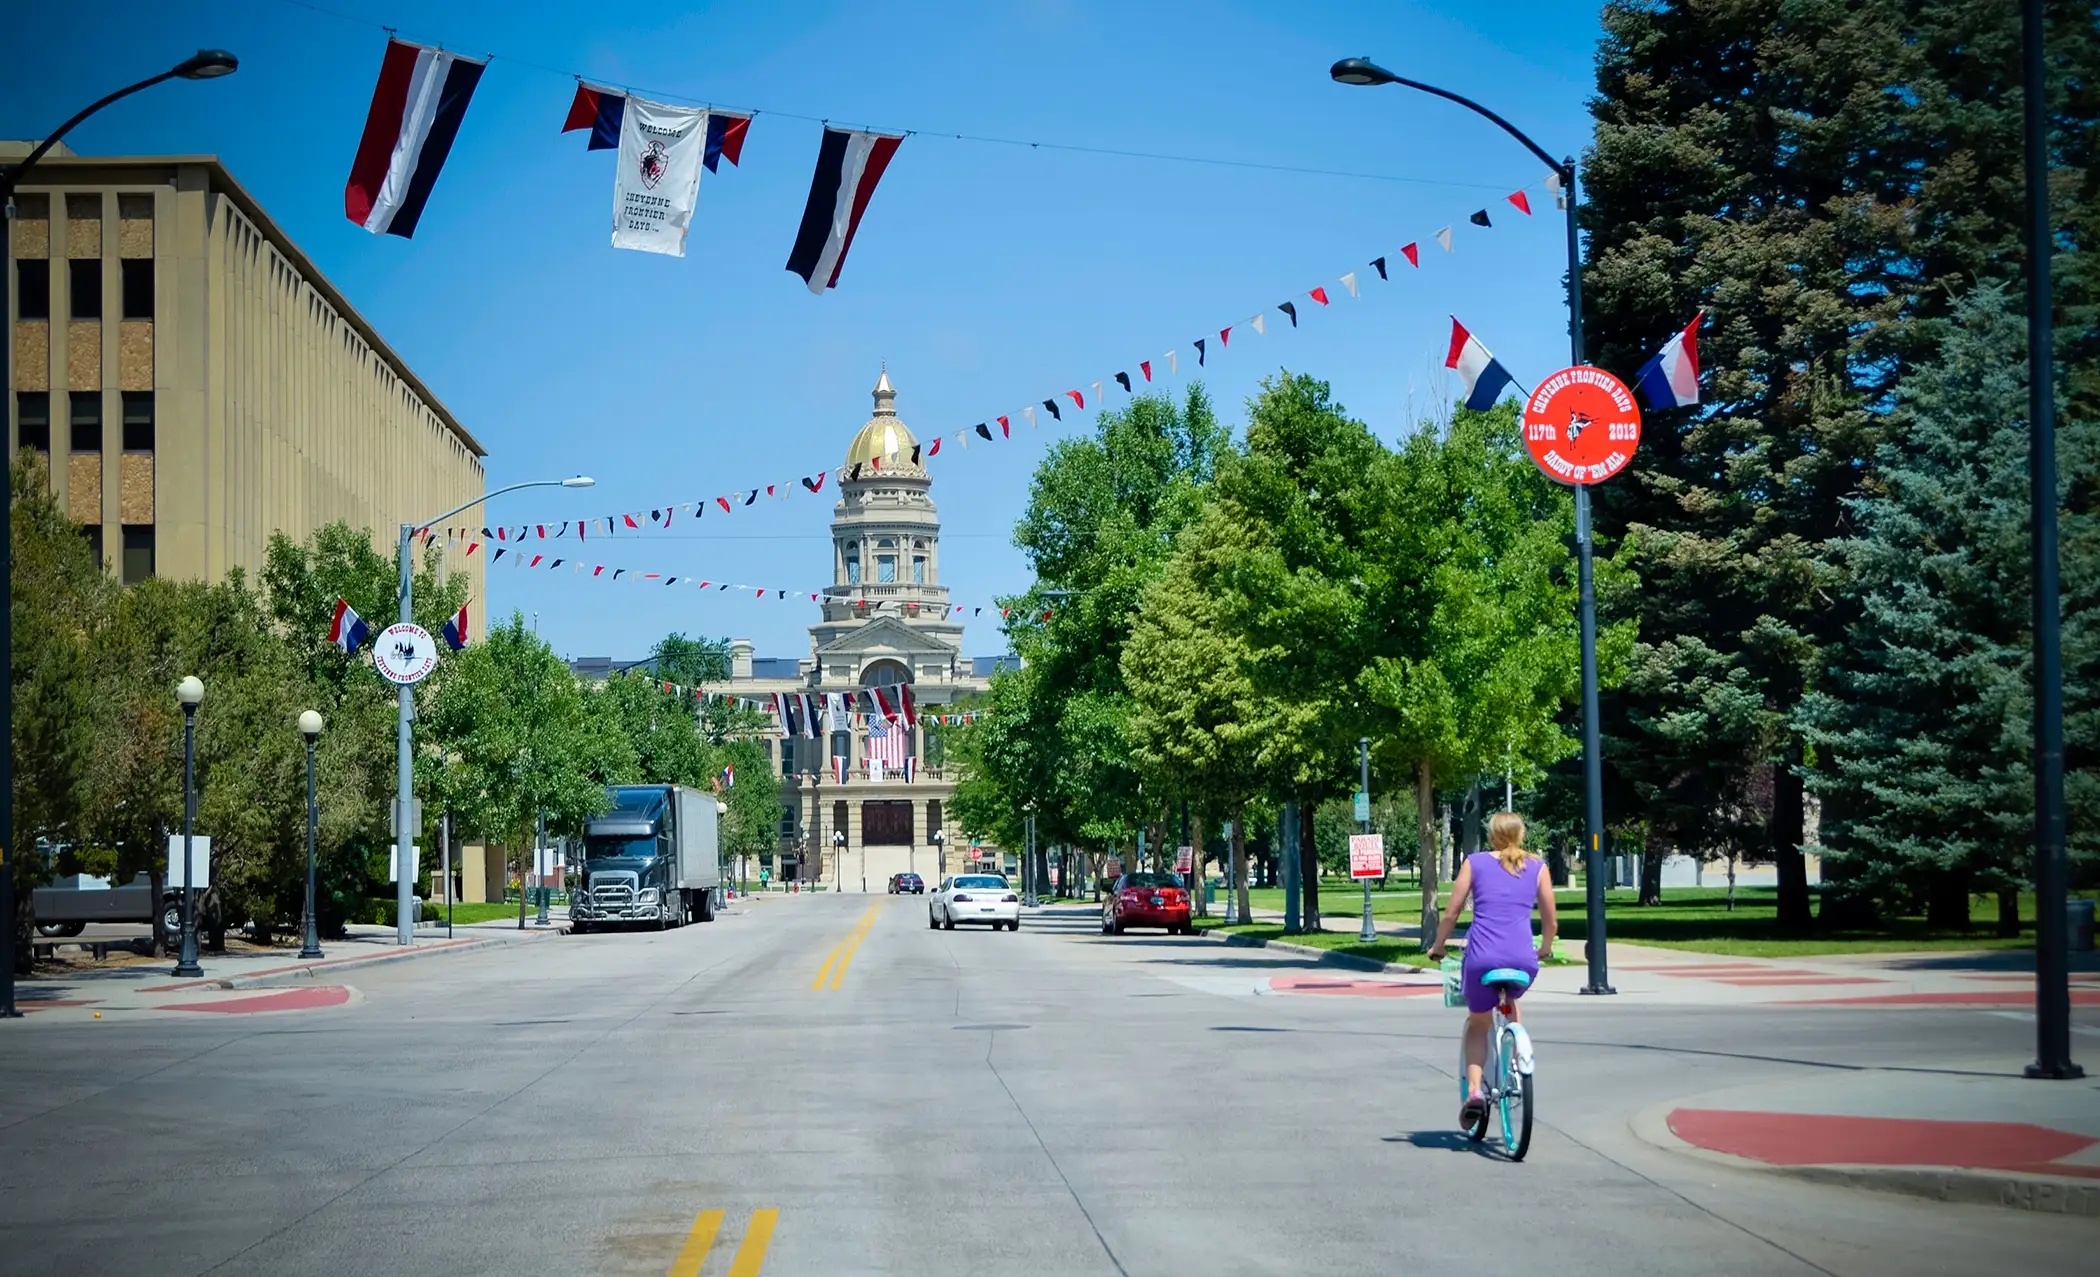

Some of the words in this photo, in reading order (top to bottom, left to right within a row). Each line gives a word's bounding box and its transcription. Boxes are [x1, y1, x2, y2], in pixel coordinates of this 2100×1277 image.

[639, 122, 682, 138] WELCOME
[625, 192, 671, 208] CHEYENNE
[624, 206, 665, 220] FRONTIER
[628, 220, 650, 231] DAYS
[1532, 373, 1570, 414] CHEYENNE
[1570, 370, 1616, 393] FRONTIER
[1611, 387, 1632, 413] DAYS
[1528, 424, 1556, 441] 117th
[1608, 423, 1637, 440] 2013
[1543, 449, 1574, 477] DADDY
[1573, 465, 1586, 479] OF
[1605, 451, 1626, 471] ALL
[388, 625, 419, 635] WELCOME
[419, 630, 427, 639] TO
